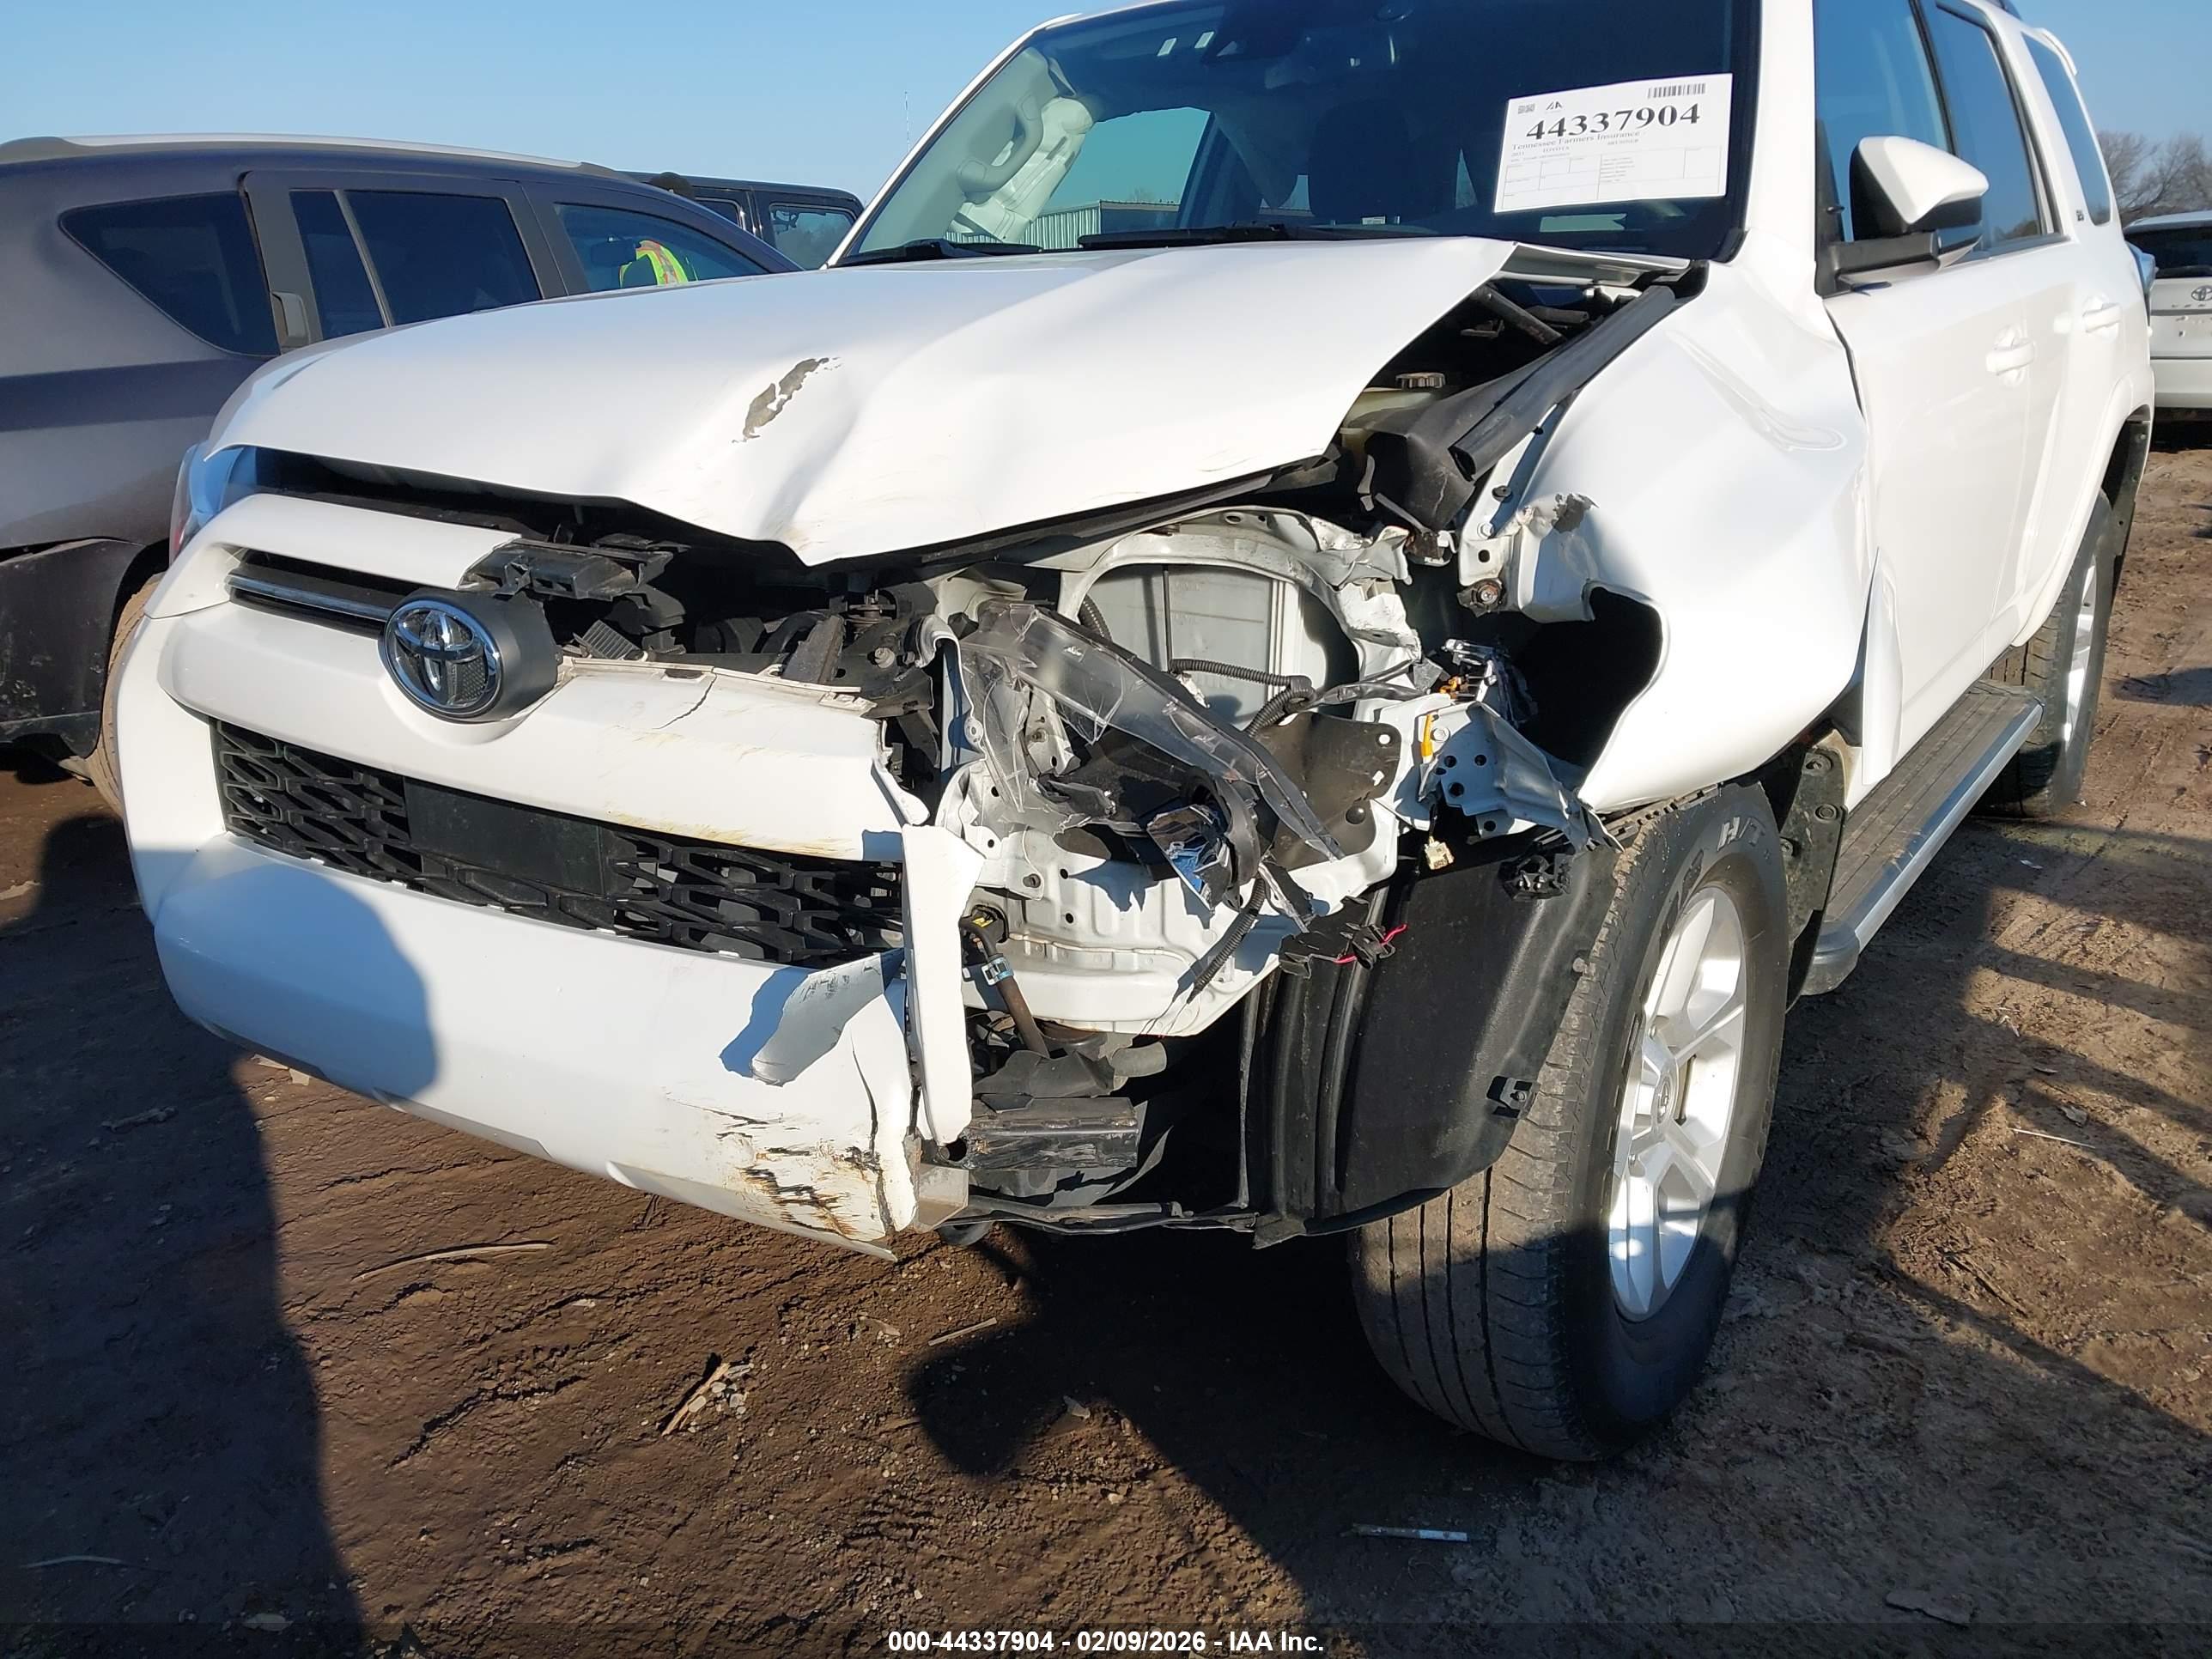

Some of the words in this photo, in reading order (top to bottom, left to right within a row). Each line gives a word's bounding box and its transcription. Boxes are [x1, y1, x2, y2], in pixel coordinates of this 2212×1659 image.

[1526, 103, 1700, 140] 44337904
[1511, 139, 1556, 151] Tennessee
[1559, 135, 1595, 146] Farmers
[1597, 131, 1641, 141] Insurance
